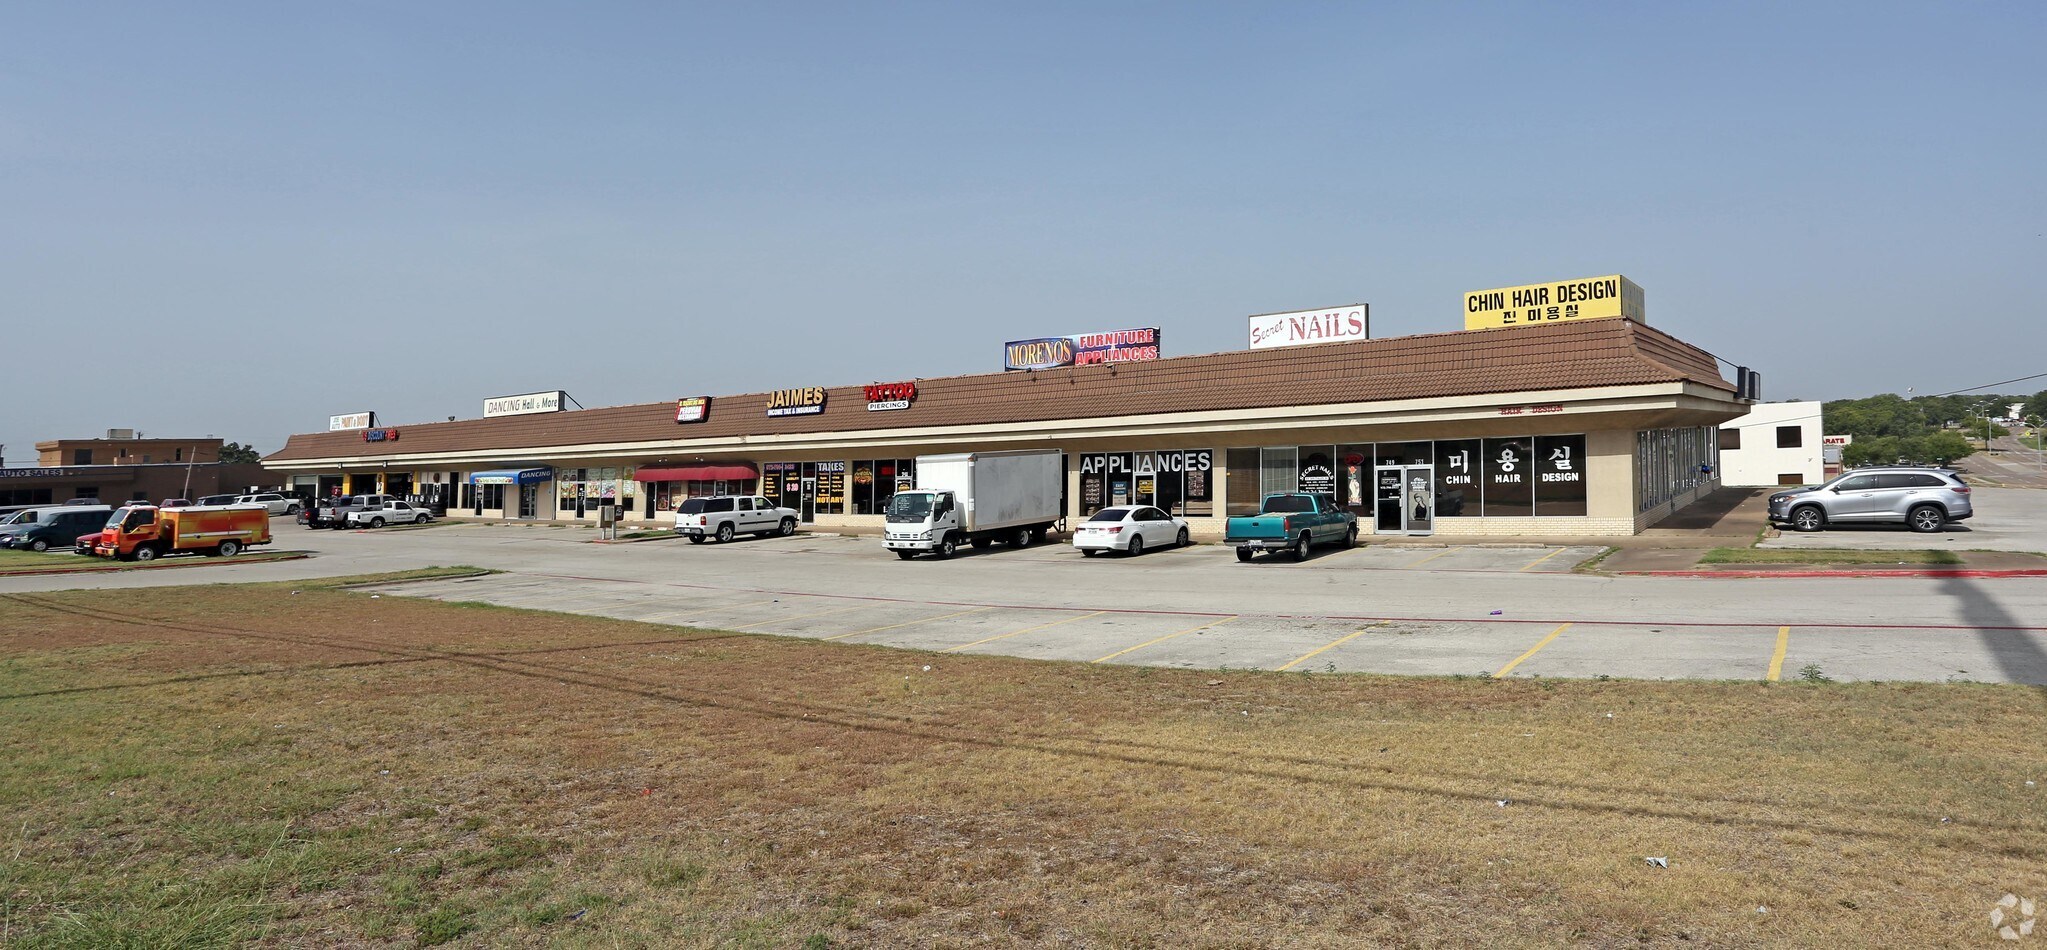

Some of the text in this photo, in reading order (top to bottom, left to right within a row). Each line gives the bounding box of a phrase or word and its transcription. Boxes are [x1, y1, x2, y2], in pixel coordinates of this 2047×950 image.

[1468, 292, 1504, 313] CHIN
[1512, 287, 1549, 308] HAIR
[1557, 279, 1617, 304] DESIGN
[1503, 304, 1579, 324] 진 미용실
[1252, 311, 1363, 344] Secret NAILS
[1079, 329, 1154, 349] FURNITURE
[1008, 338, 1071, 366] MORENO'S
[1075, 346, 1157, 365] APPLIANCES
[766, 386, 824, 408] JAIMES
[864, 382, 915, 400] TATTOO
[488, 400, 520, 413] DANCING
[522, 398, 535, 410] Hall
[541, 397, 557, 408] More
[767, 408, 782, 416] INCOME
[782, 407, 792, 415] TAX
[796, 405, 820, 414] INSURANCE
[869, 401, 907, 410] PIERCINGS
[1531, 404, 1563, 414] DESIGN
[817, 462, 844, 472] TAXES
[1080, 452, 1211, 474] APPLIANCES
[1448, 446, 1573, 474] 미 용 실
[0, 469, 61, 478] AUTO SALES
[521, 470, 551, 479] DANCING
[1299, 465, 1335, 481] SECRET NAILS
[1445, 475, 1471, 485] CHIN
[1495, 474, 1521, 483] HAIR
[1542, 472, 1579, 482] DESIGN
[816, 496, 844, 504] NOTARY
